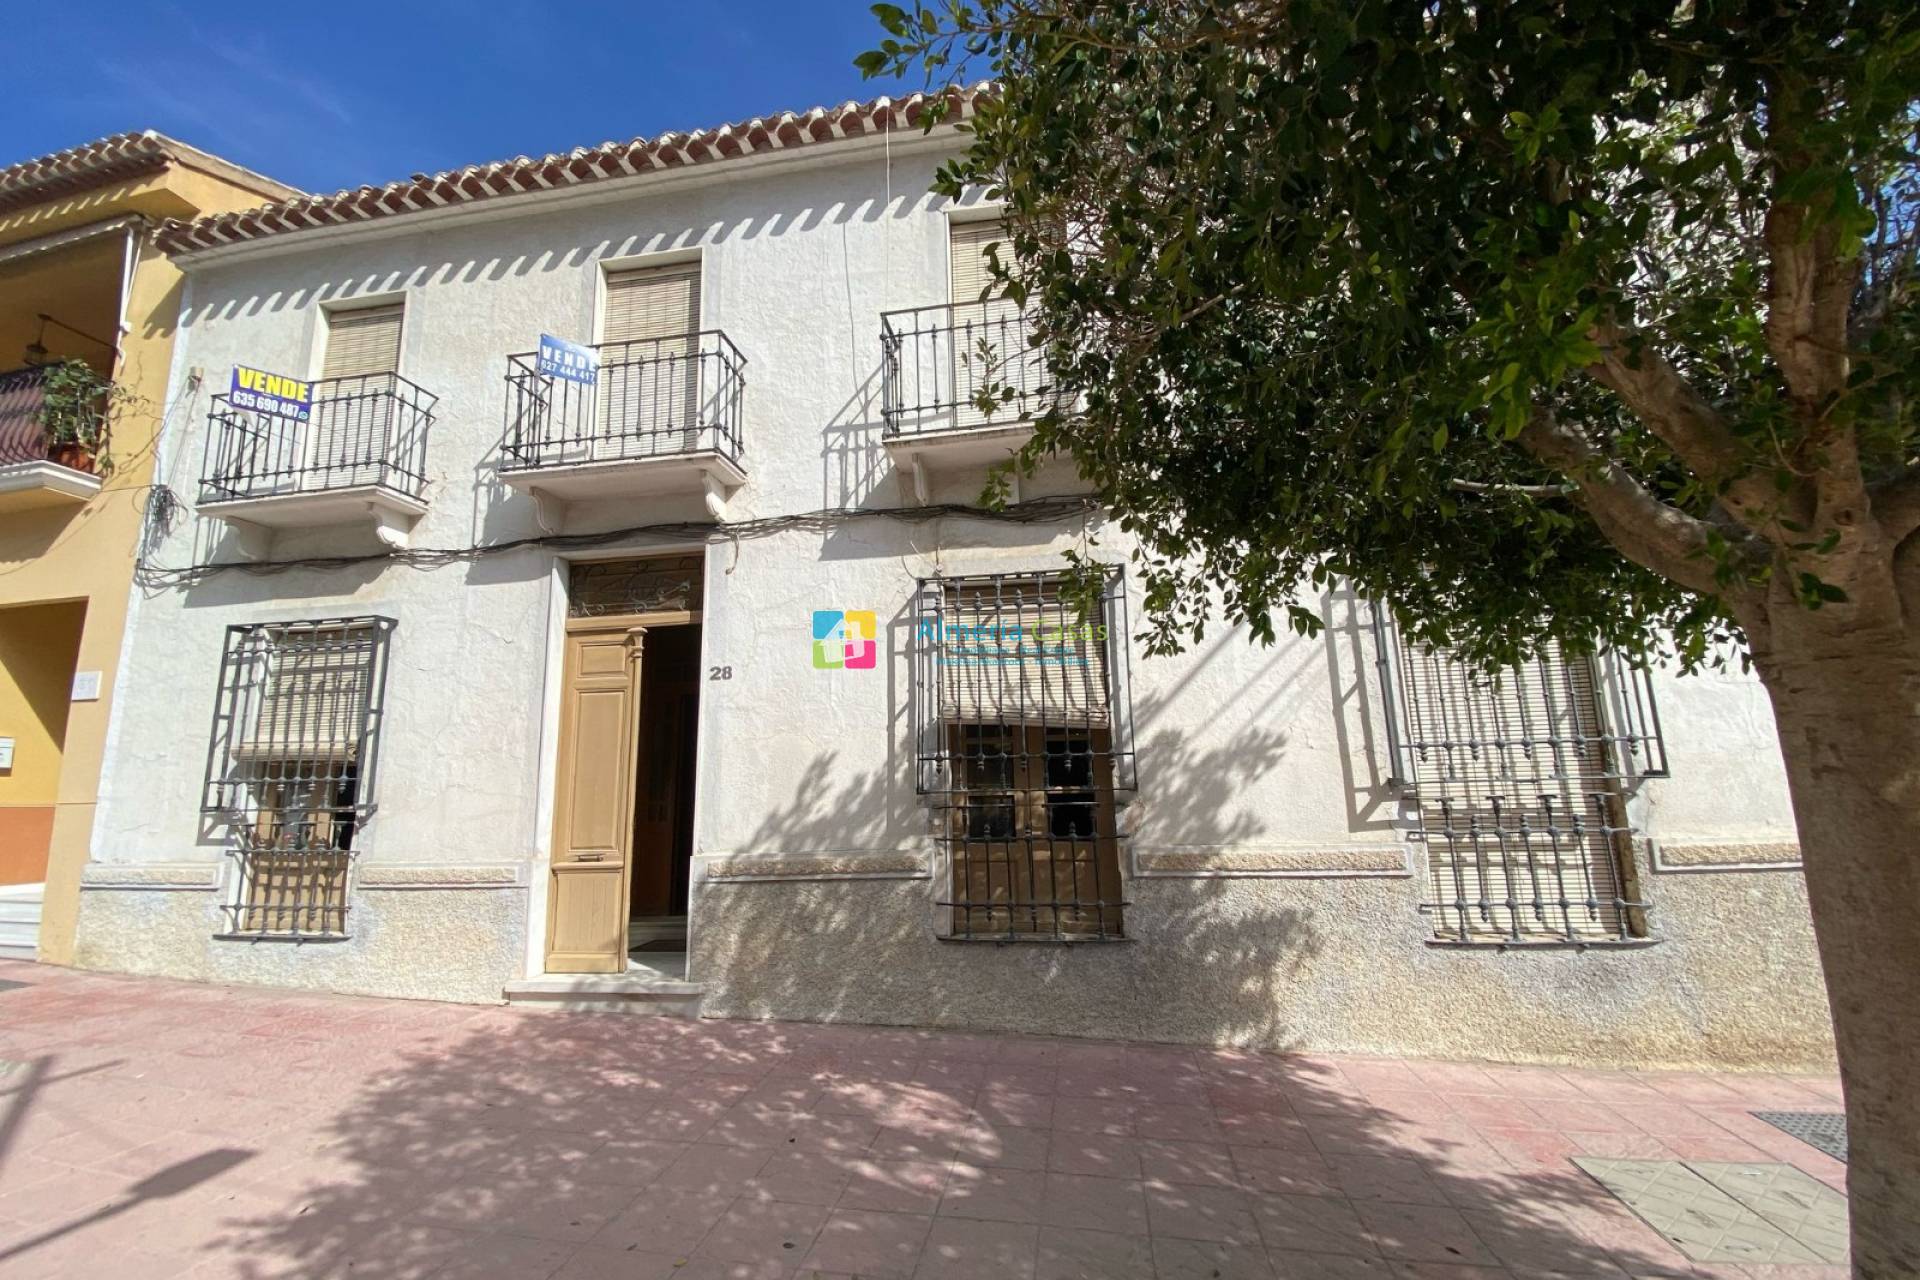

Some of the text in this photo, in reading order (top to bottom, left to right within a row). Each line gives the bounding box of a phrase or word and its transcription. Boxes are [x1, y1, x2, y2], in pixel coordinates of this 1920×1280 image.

[542, 345, 596, 371] VENDE
[560, 365, 577, 377] 444
[238, 367, 308, 403] VENDE
[233, 391, 300, 418] 635 690 487
[709, 665, 733, 681] 28
